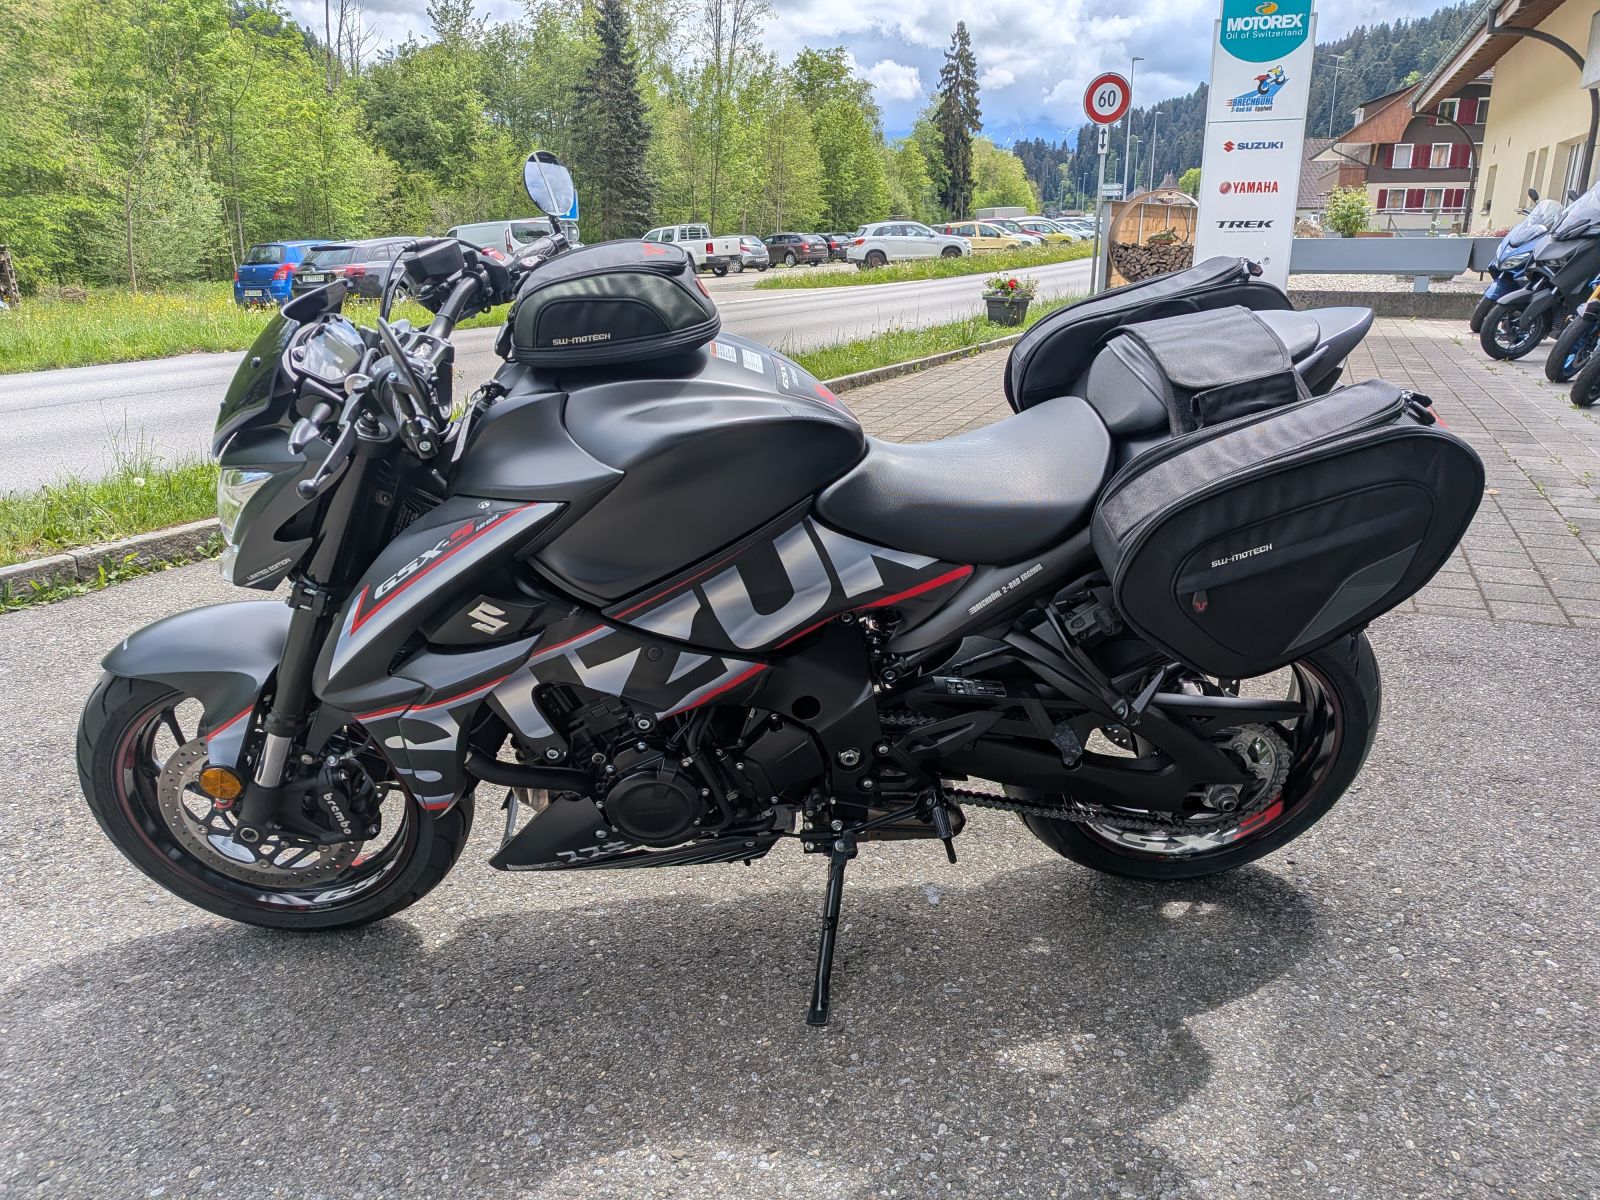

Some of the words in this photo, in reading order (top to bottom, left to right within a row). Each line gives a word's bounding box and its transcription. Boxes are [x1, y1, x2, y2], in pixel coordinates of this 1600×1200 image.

[1226, 13, 1304, 32] MOTOREX
[1226, 32, 1238, 40] Oil
[1240, 31, 1250, 39] of
[1252, 28, 1303, 39] Switzerland
[1098, 90, 1116, 108] 60
[1236, 141, 1284, 151] SUZUKI
[1233, 181, 1279, 194] YAMAHA
[1215, 220, 1275, 229] TREK
[552, 332, 611, 346] SW-MOTECH
[373, 518, 476, 601] GSX-S
[1211, 543, 1273, 568] SW-MOTECH
[246, 568, 270, 581] LIMITED
[268, 557, 292, 572] EDITION
[1001, 577, 1021, 594] 2-RAD
[323, 792, 352, 835] brembo
